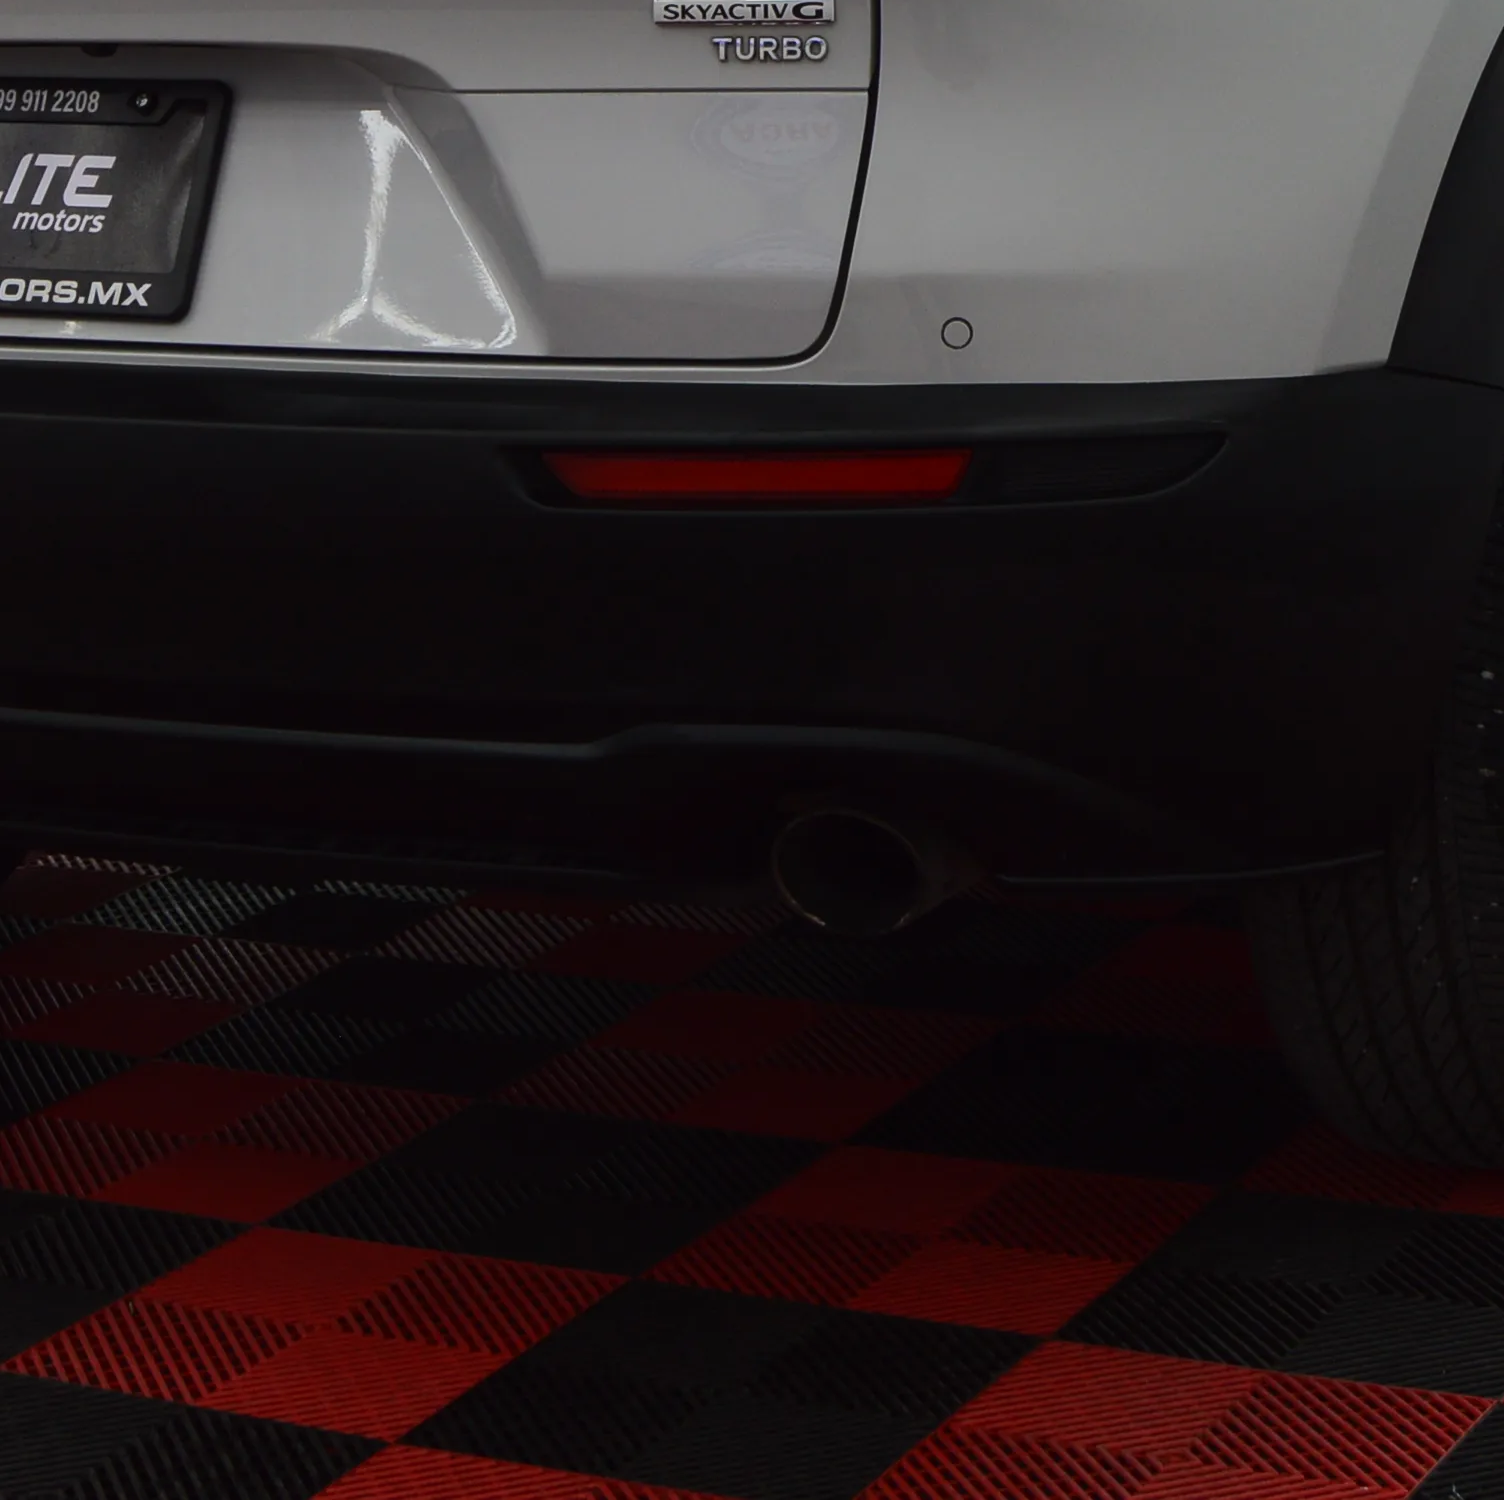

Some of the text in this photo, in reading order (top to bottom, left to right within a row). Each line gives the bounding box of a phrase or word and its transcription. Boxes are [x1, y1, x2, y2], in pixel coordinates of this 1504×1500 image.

[711, 36, 828, 61] TURBO
[20, 90, 46, 112] 911
[51, 90, 100, 113] 2208
[12, 209, 106, 234] motors
